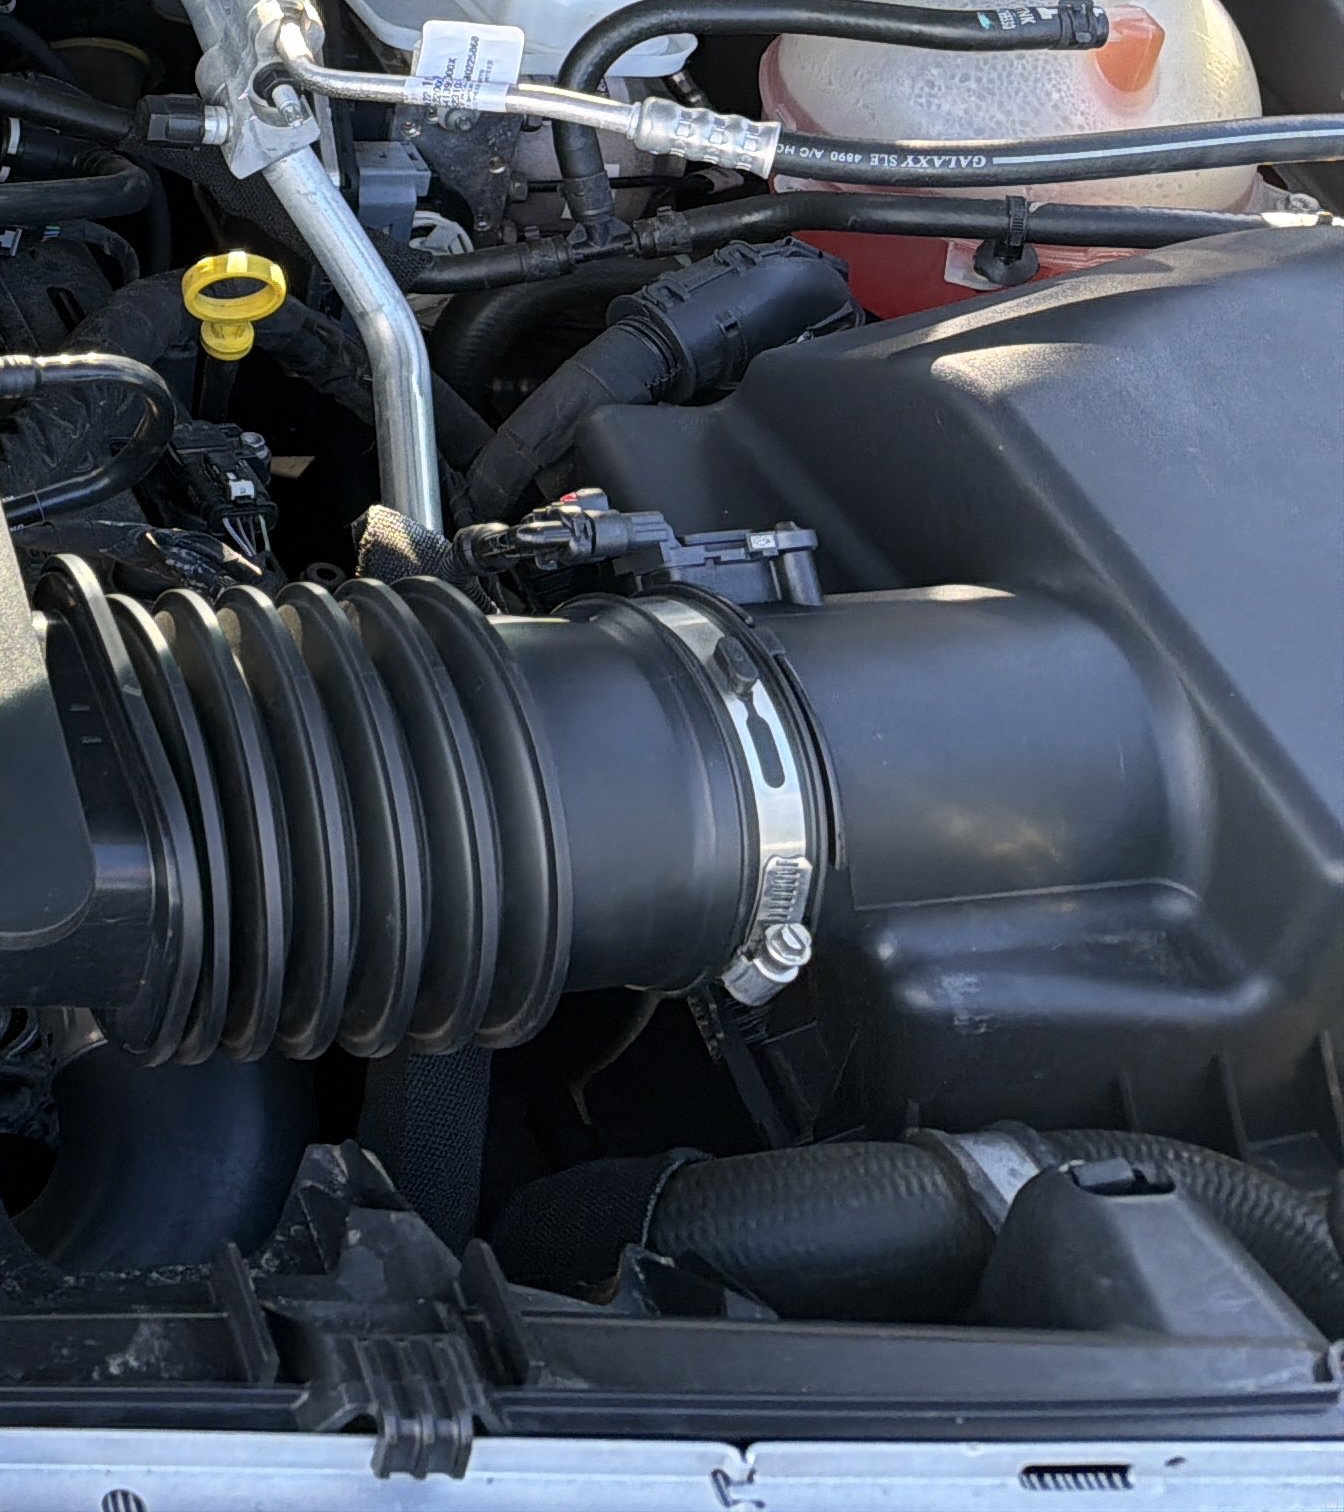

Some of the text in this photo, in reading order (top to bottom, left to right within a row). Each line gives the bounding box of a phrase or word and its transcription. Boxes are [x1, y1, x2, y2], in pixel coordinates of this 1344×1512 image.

[799, 147, 825, 160] A/C
[869, 152, 898, 167] SLE
[901, 154, 987, 169] GALAXY
